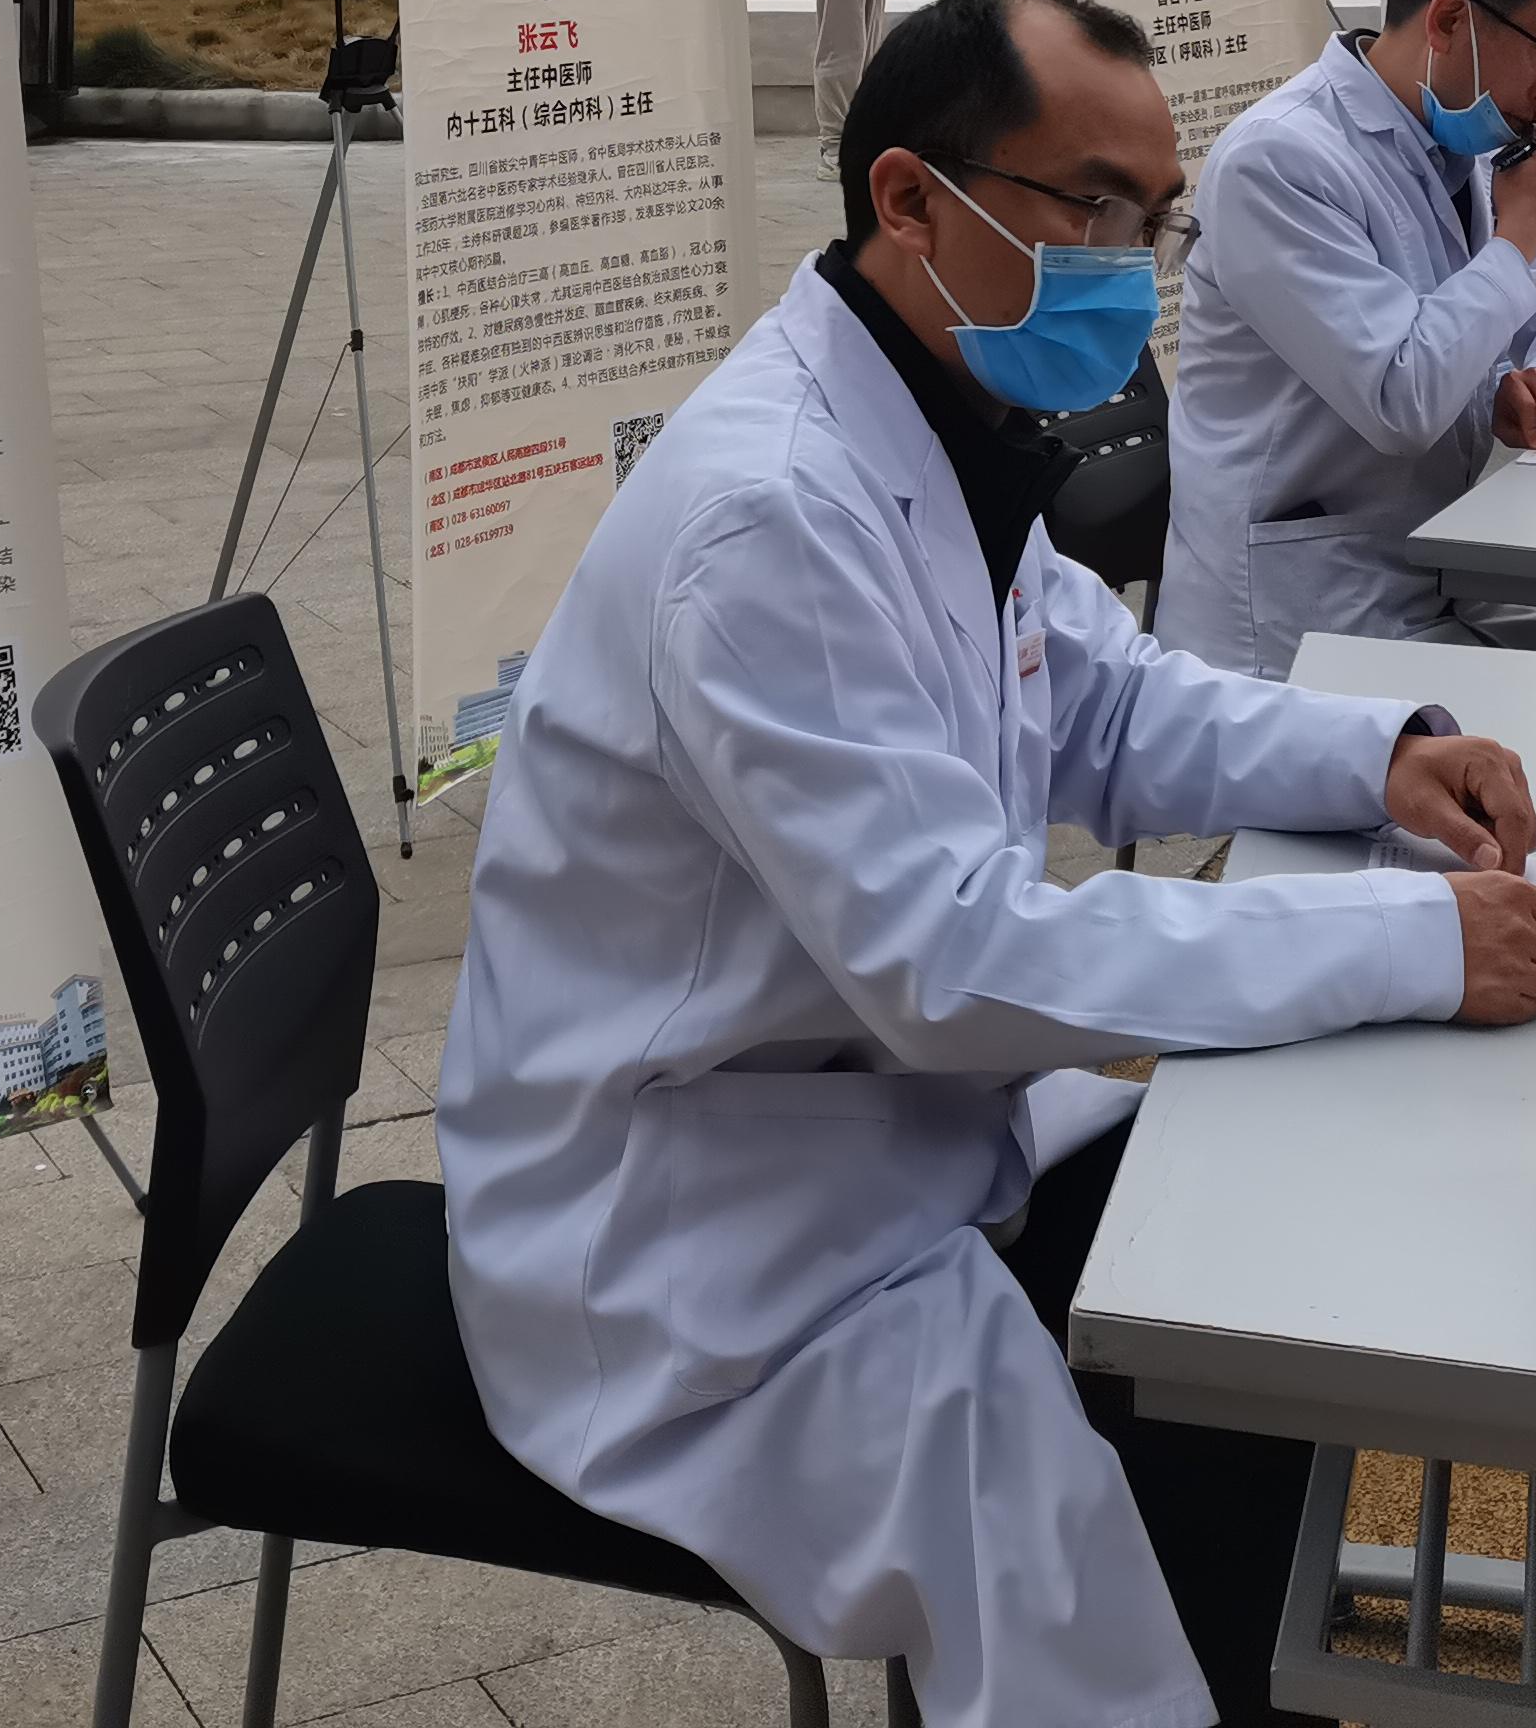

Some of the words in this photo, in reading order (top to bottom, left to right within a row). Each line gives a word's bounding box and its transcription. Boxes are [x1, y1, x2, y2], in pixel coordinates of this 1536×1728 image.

[518, 20, 579, 54] 张云飞
[1153, 11, 1212, 37] 主任中医师
[507, 61, 592, 93] 主任中医师
[447, 91, 654, 140] 内十五科（综合内科）主任
